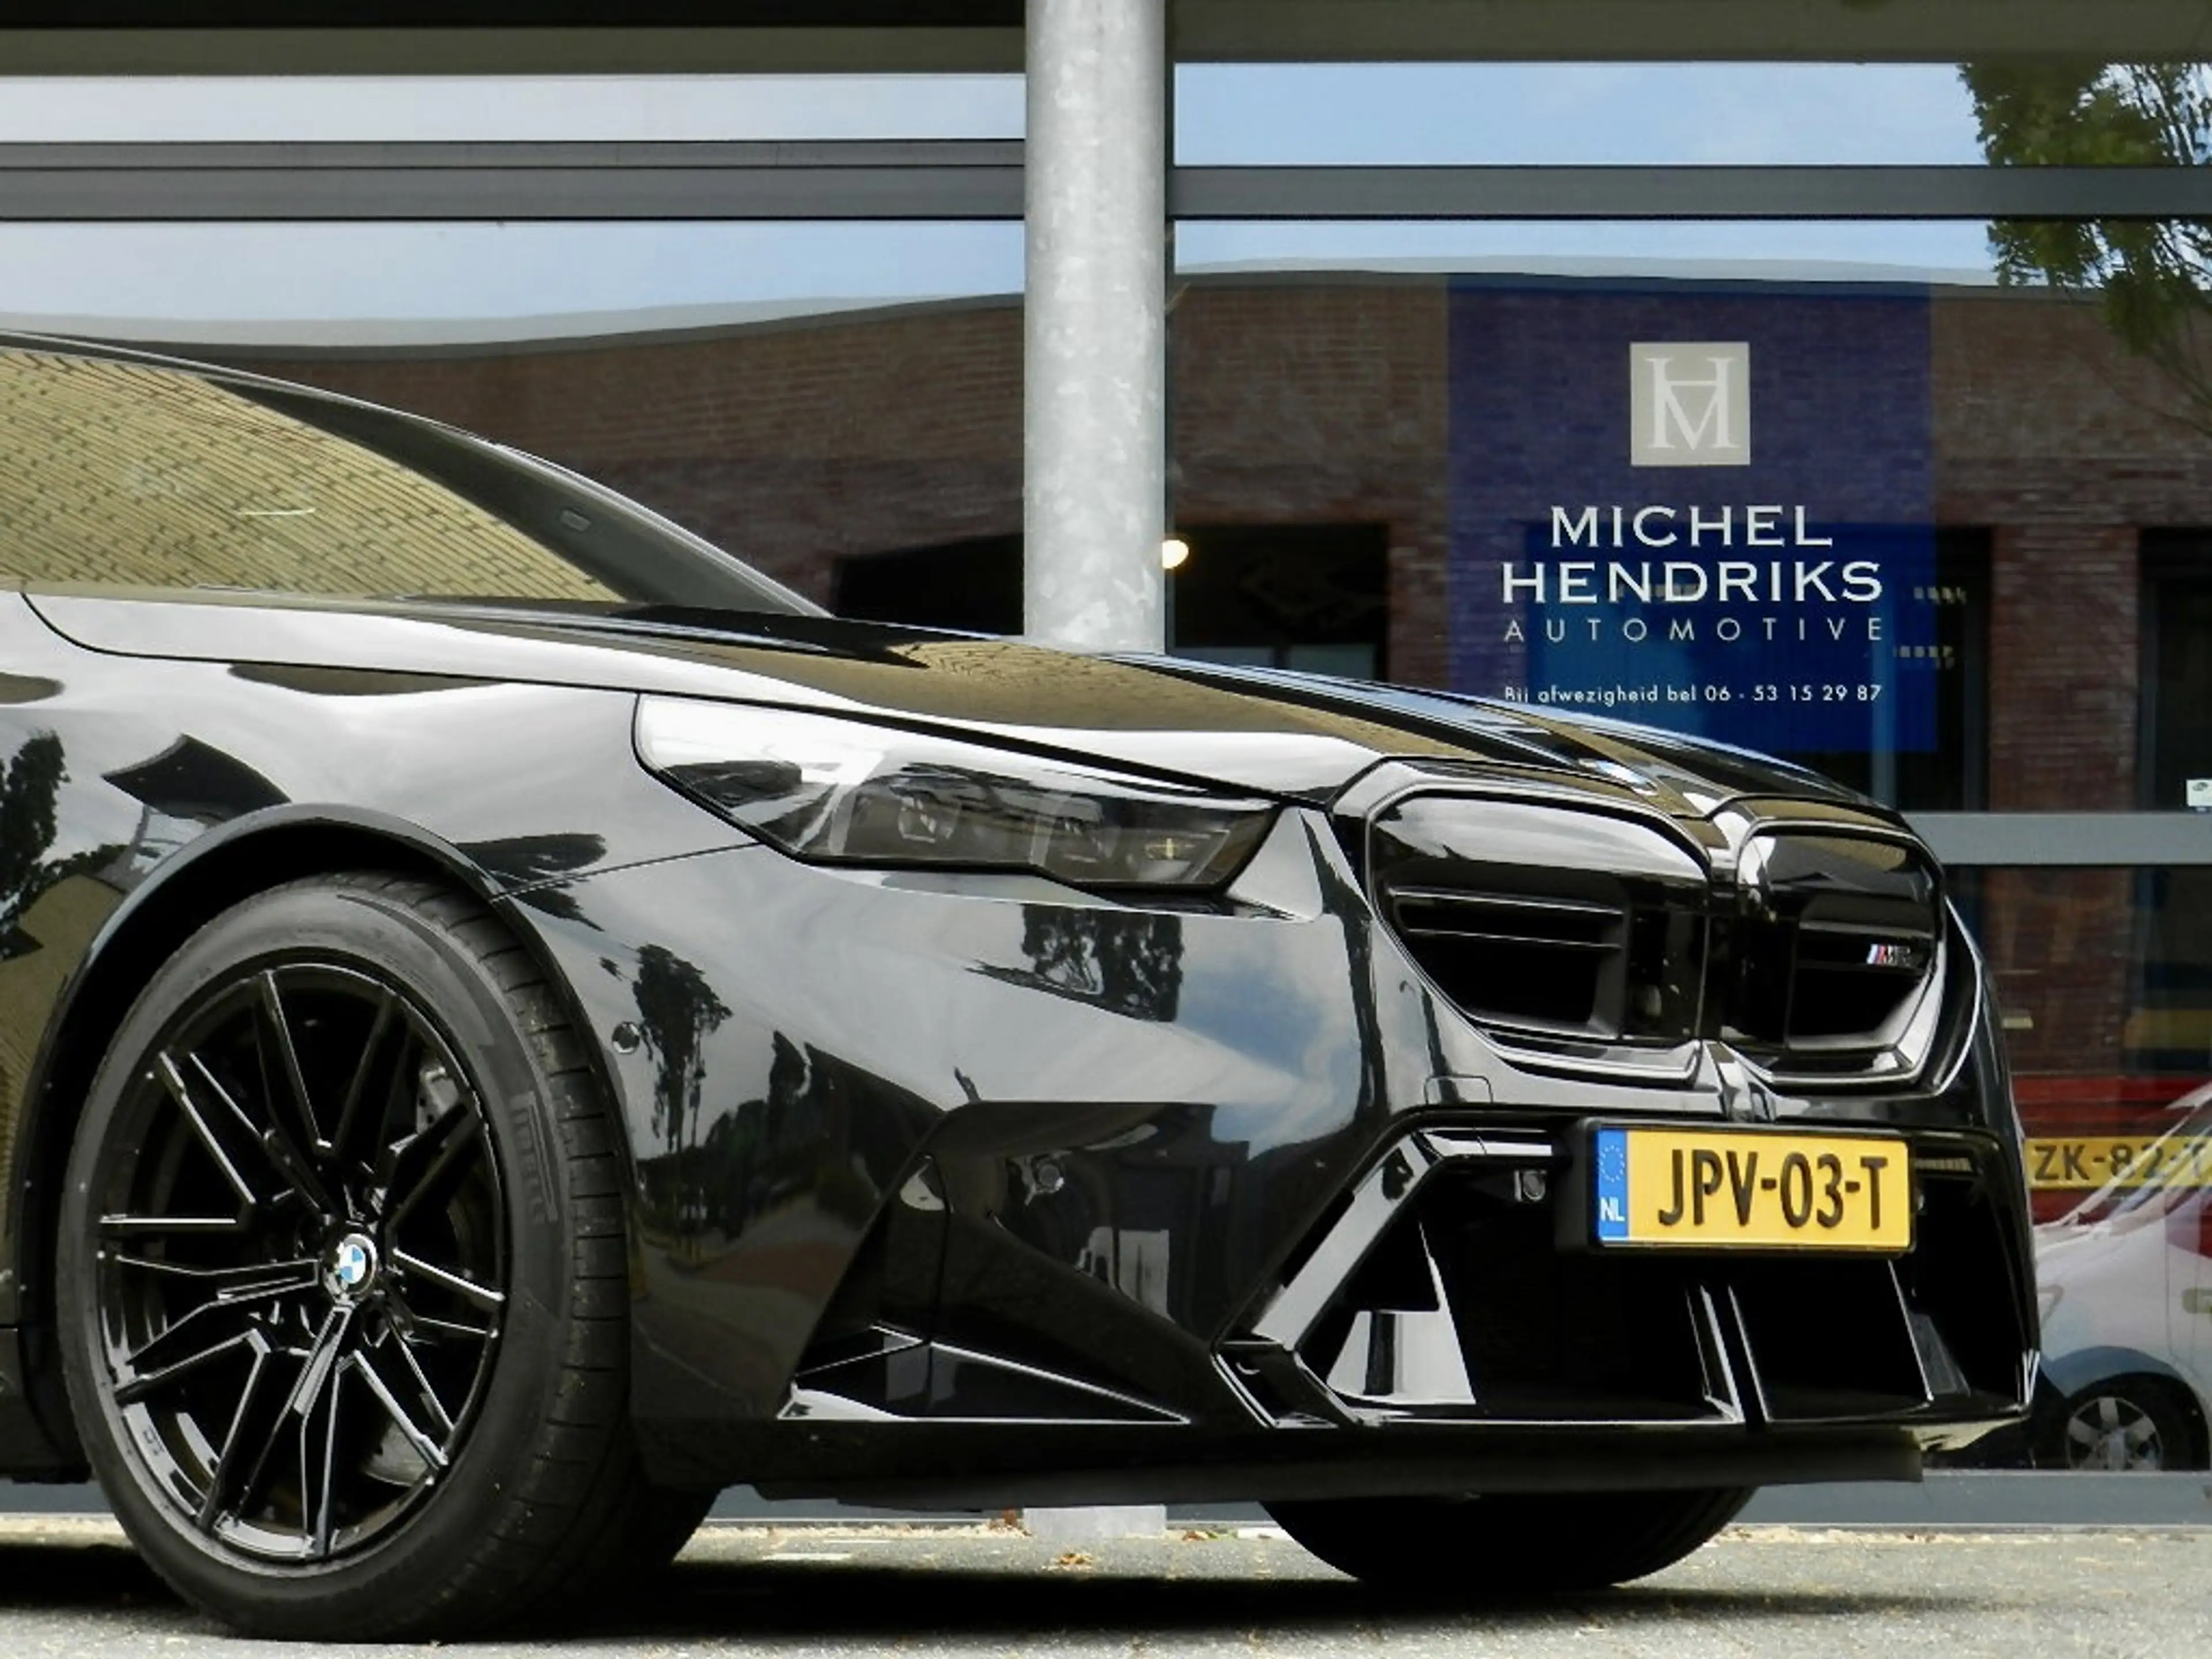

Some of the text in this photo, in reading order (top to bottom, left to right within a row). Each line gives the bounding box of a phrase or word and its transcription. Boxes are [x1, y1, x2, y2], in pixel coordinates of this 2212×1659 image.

[1551, 505, 1833, 547] MICHEL
[1501, 561, 1883, 604] HENDRIKS
[1504, 618, 1883, 641] AUTOMOTIVE
[1537, 684, 1658, 707] afwezigheid
[1666, 684, 1697, 702] bel
[1703, 684, 1730, 702] 06
[1753, 684, 1777, 701] 53
[1789, 684, 1812, 701] 15
[1823, 684, 1848, 701] 29
[1856, 684, 1882, 701] 87
[1657, 1149, 1889, 1230] JPV-03-T
[1600, 1196, 1625, 1222] NL
